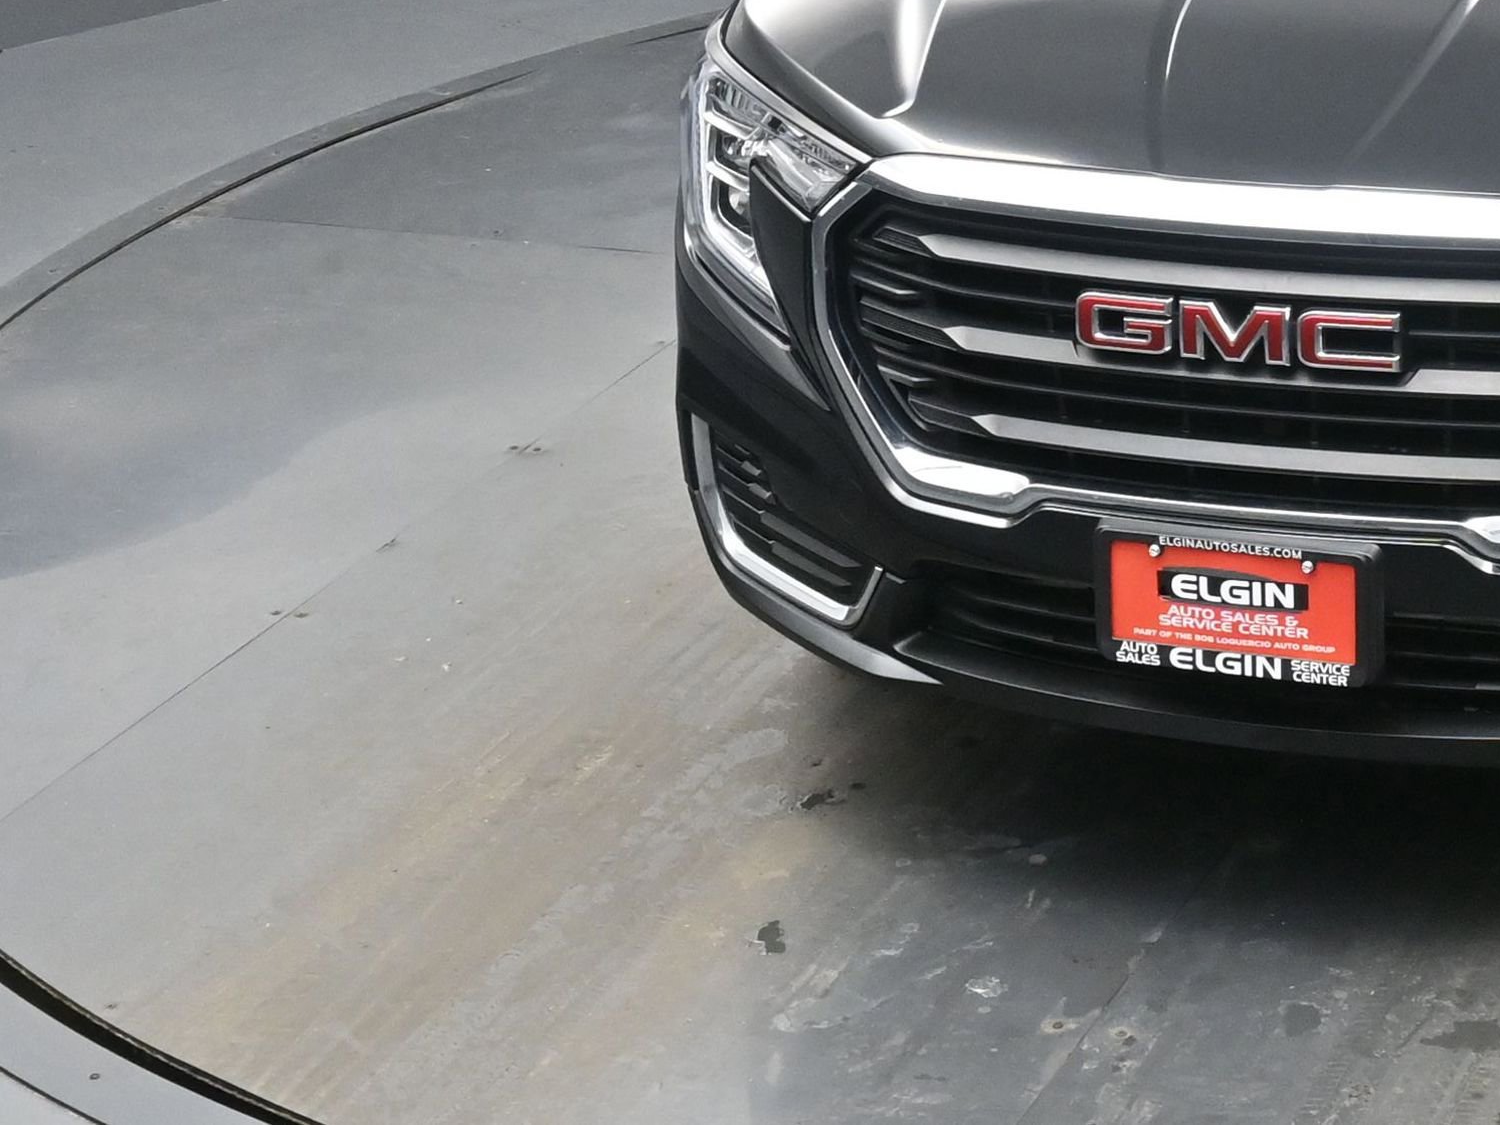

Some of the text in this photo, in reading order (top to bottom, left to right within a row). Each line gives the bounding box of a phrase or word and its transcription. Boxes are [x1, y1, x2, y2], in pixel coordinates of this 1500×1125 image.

[1076, 291, 1400, 372] GMC
[1159, 536, 1302, 559] ELGINAUTOSALES.COM
[1171, 573, 1295, 609] ELGIN
[1158, 614, 1309, 639] SERVICE CENTER
[1167, 605, 1299, 627] AUTO SALES &
[1120, 640, 1158, 655] AUTO
[1133, 627, 1157, 636] PART
[1159, 630, 1173, 638] OF
[1175, 632, 1193, 641] THE
[1194, 634, 1215, 643] BOB
[1274, 642, 1300, 651] AUTO
[1302, 644, 1336, 654] GROUP
[1116, 651, 1161, 666] SALES
[1169, 647, 1282, 680] ELGIN
[1290, 660, 1350, 676] SERVICE
[1292, 671, 1348, 687] CENTER
